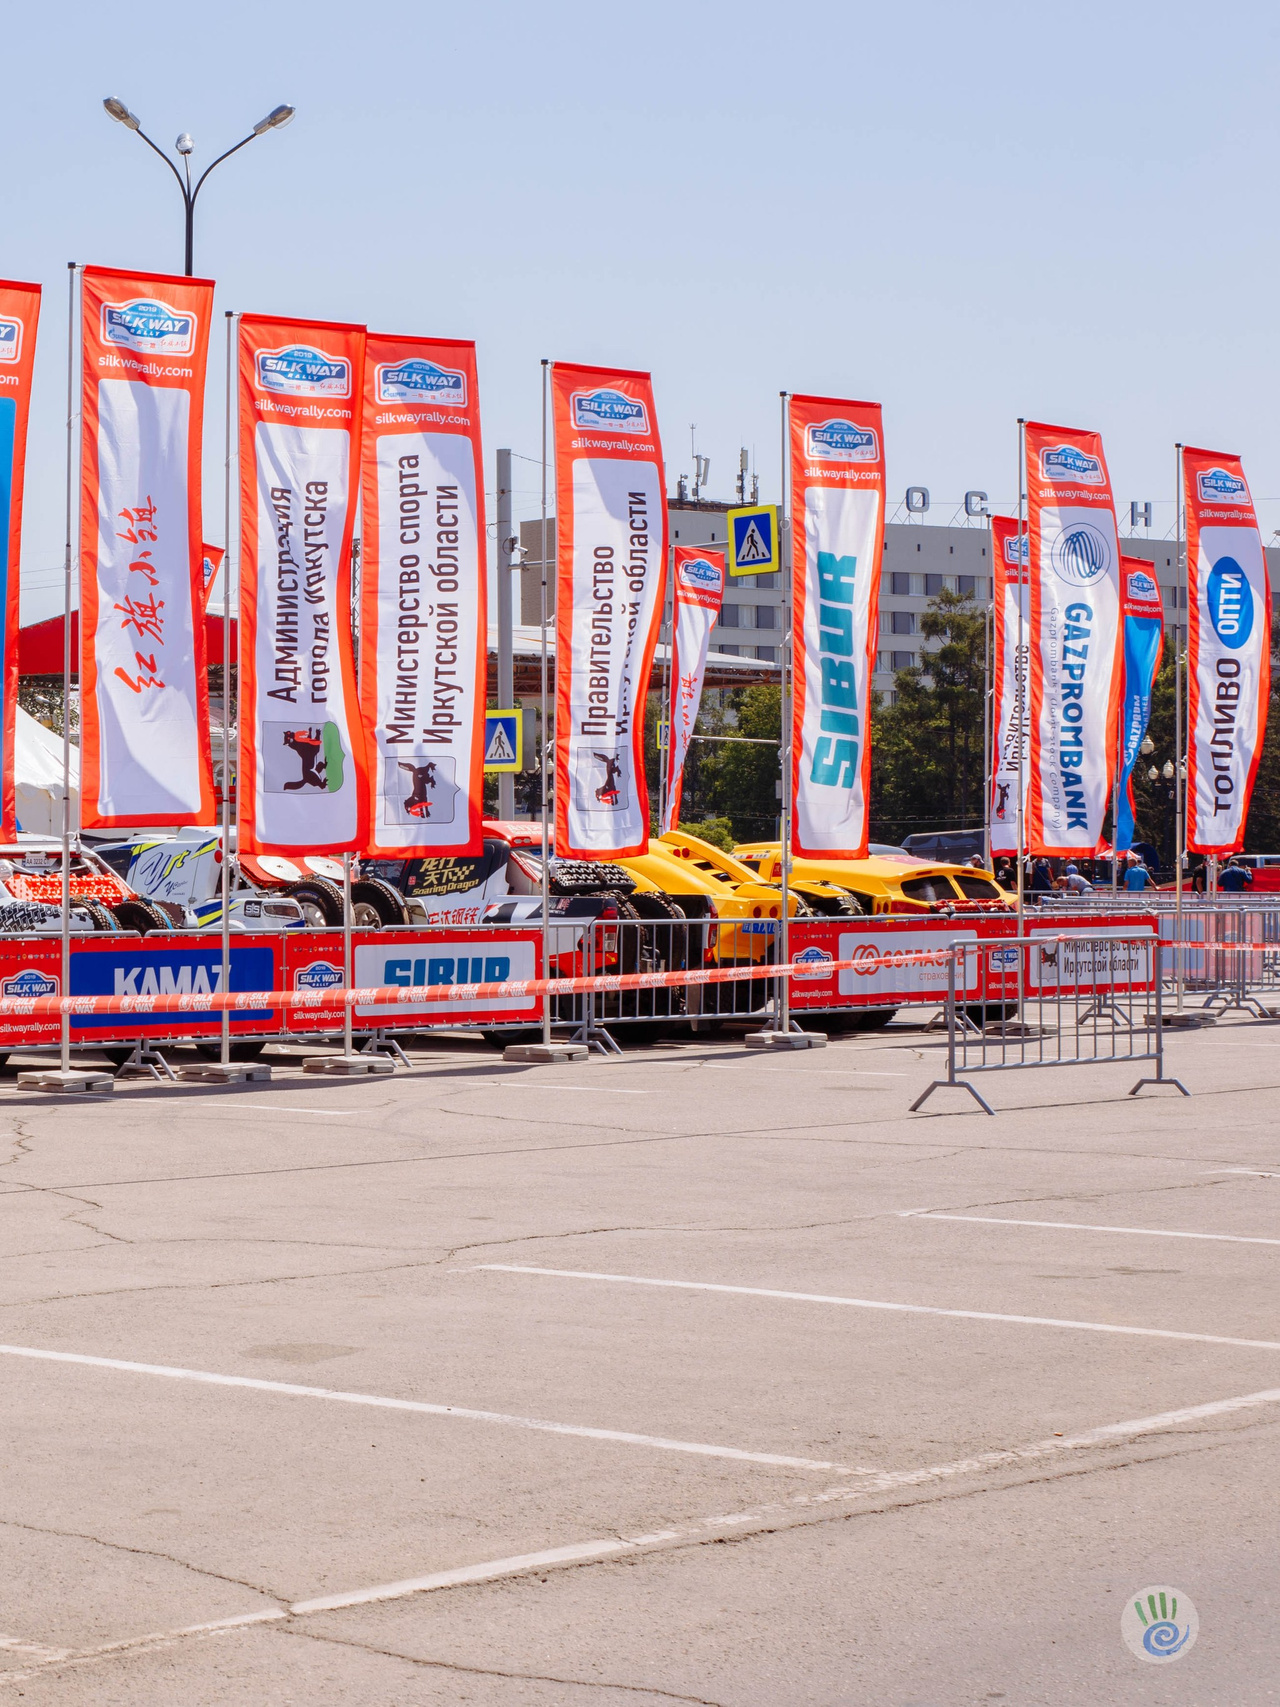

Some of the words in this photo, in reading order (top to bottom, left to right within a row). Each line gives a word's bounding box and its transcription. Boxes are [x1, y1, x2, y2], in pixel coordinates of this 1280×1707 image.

[112, 313, 147, 328] SILK
[149, 318, 185, 332] WAY
[130, 328, 160, 336] RALLY
[265, 359, 304, 373] SILK
[306, 364, 341, 376] WAY
[386, 372, 423, 383] SILK
[425, 375, 457, 386] WAY
[255, 399, 351, 419] silkwayrally.com
[581, 401, 611, 412] SILK
[613, 405, 639, 415] WAY
[376, 412, 470, 426] silkwayrally.com
[572, 437, 655, 452] silkwayrally.com
[815, 432, 843, 442] SILK
[844, 434, 869, 443] WAY
[1049, 455, 1074, 464] SILK
[1075, 459, 1094, 469] WAY
[804, 467, 881, 481] silkwayrally.com
[1204, 479, 1224, 487] SILK
[399, 454, 428, 545] спорта
[1039, 488, 1110, 501] silkwayrally.com
[304, 481, 329, 605] Иркутска
[429, 484, 458, 592] области
[622, 492, 649, 594] области
[1217, 573, 1243, 634] ОПТИ
[581, 545, 615, 737] Правительство
[386, 554, 420, 745] Министерство
[422, 601, 463, 745] Иркутской
[810, 550, 859, 789] SIBUR
[1060, 602, 1094, 830] GAZPROMBANK
[1128, 695, 1141, 748] GAZPROM
[1211, 657, 1240, 817] ТОПЛИВО
[412, 884, 446, 895] Soaring
[882, 948, 964, 968] СОГЛАСЕ
[300, 975, 320, 983] SILK
[919, 971, 965, 984] страховние
[7, 984, 30, 993] SILK
[32, 983, 53, 992] WAY
[75, 1005, 95, 1014] WAY
[135, 1003, 155, 1012] WAY
[193, 1002, 213, 1010] WAY
[250, 1001, 268, 1009] WAY
[0, 1022, 60, 1033] silkwayrally.com
